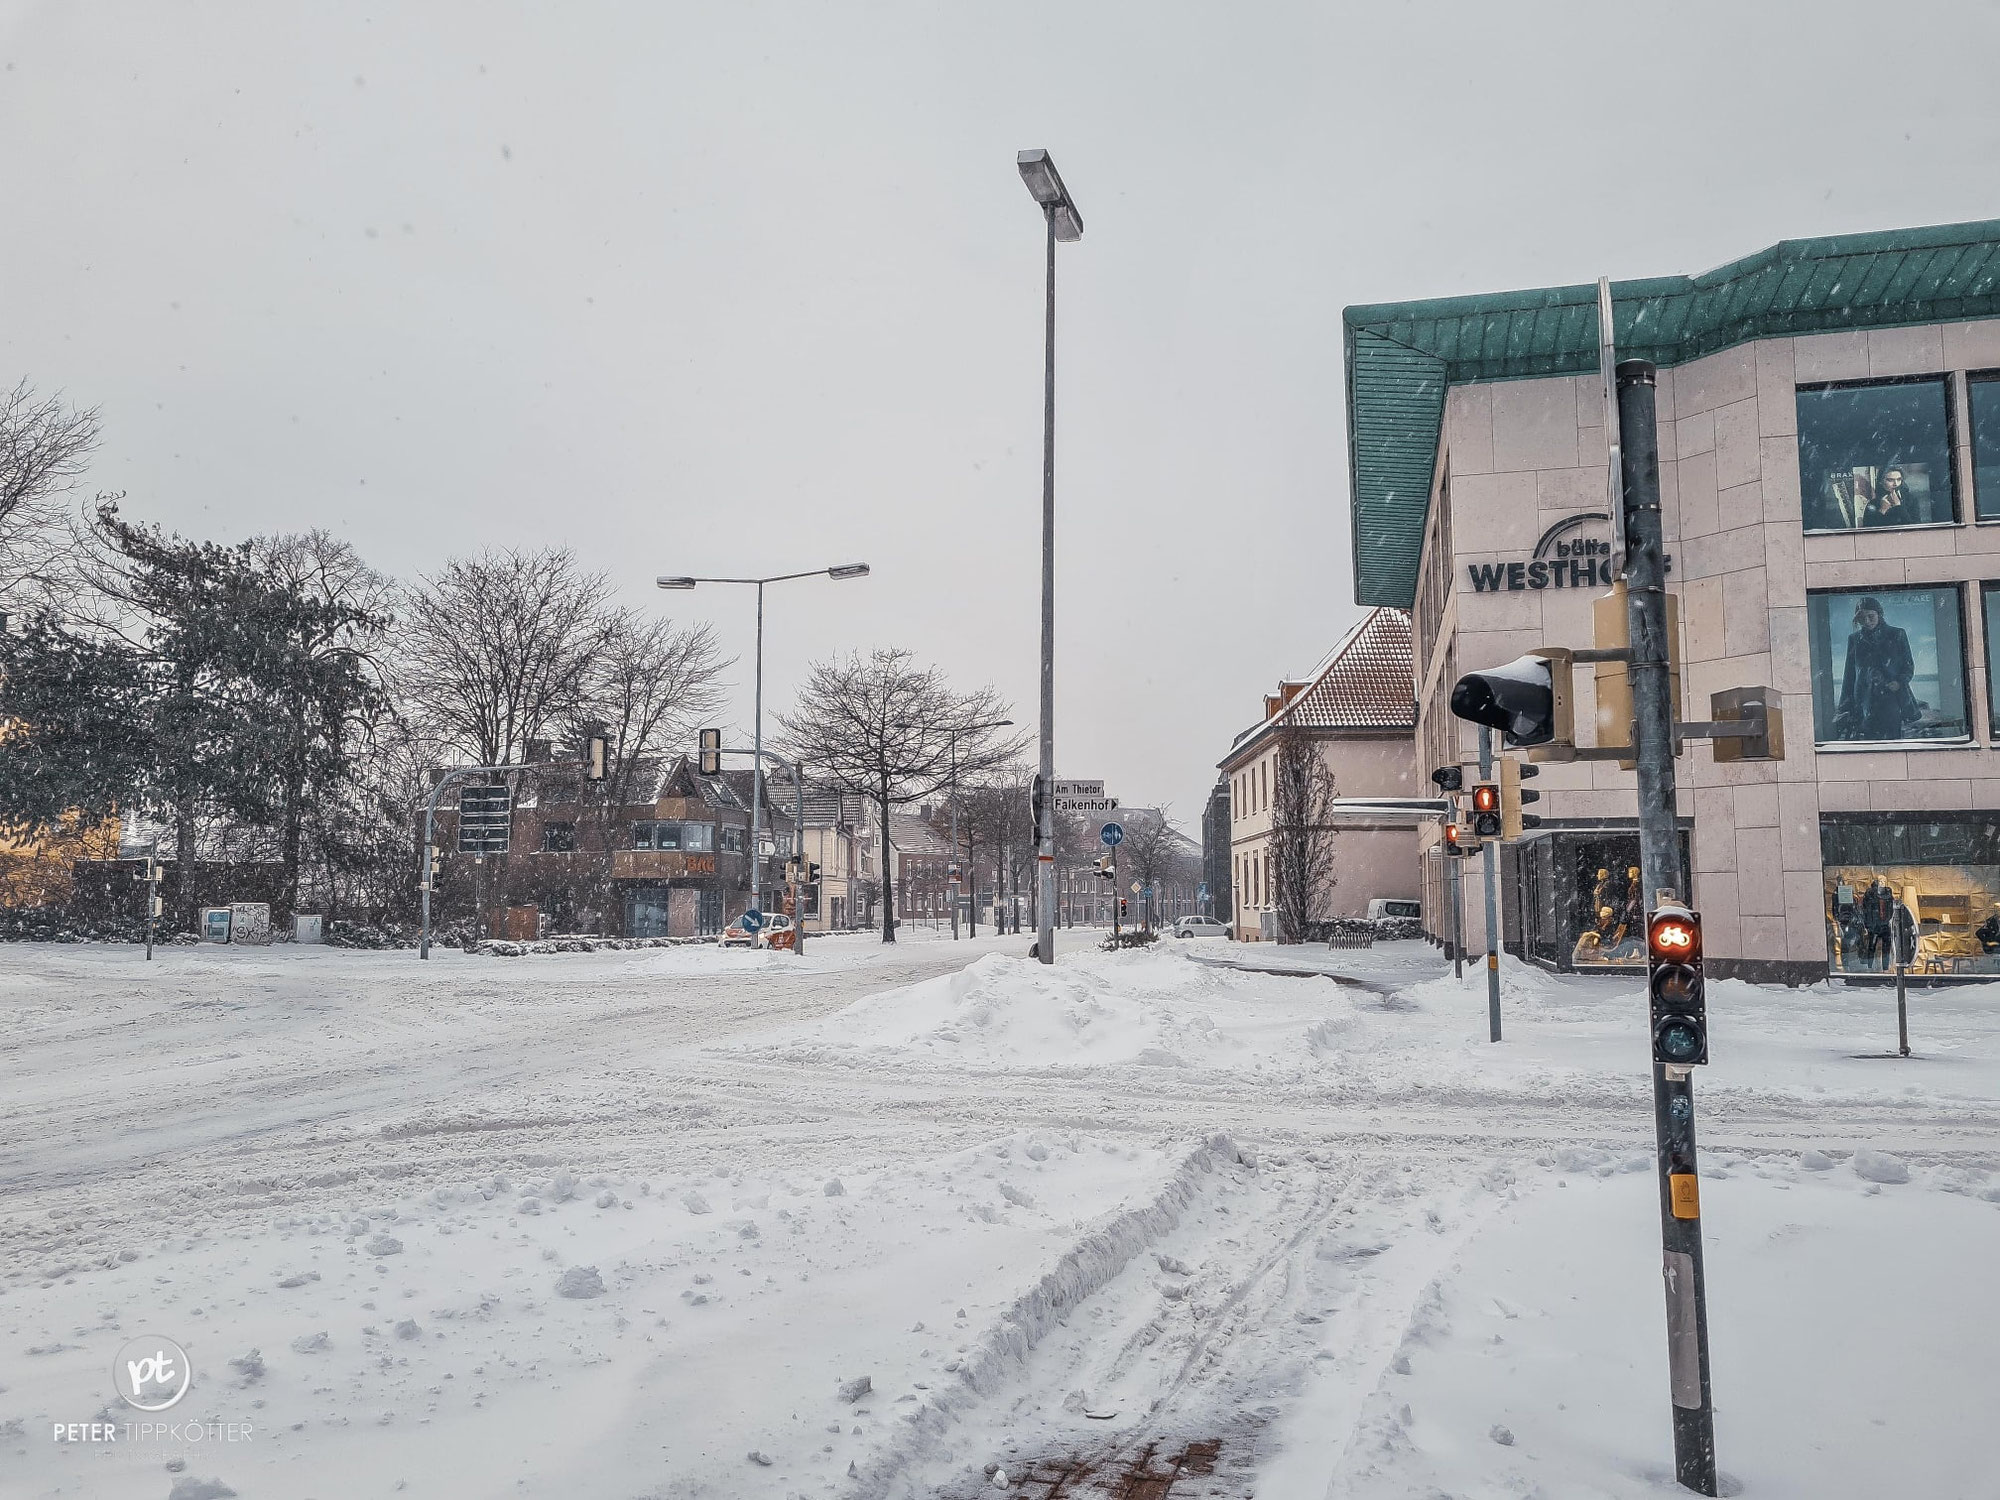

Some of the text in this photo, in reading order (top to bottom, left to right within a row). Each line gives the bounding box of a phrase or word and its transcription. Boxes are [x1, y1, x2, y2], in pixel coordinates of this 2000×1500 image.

[1557, 538, 1610, 557] bülte
[1055, 784, 1101, 794] Am Thietor
[1054, 799, 1109, 811] Falkenhof
